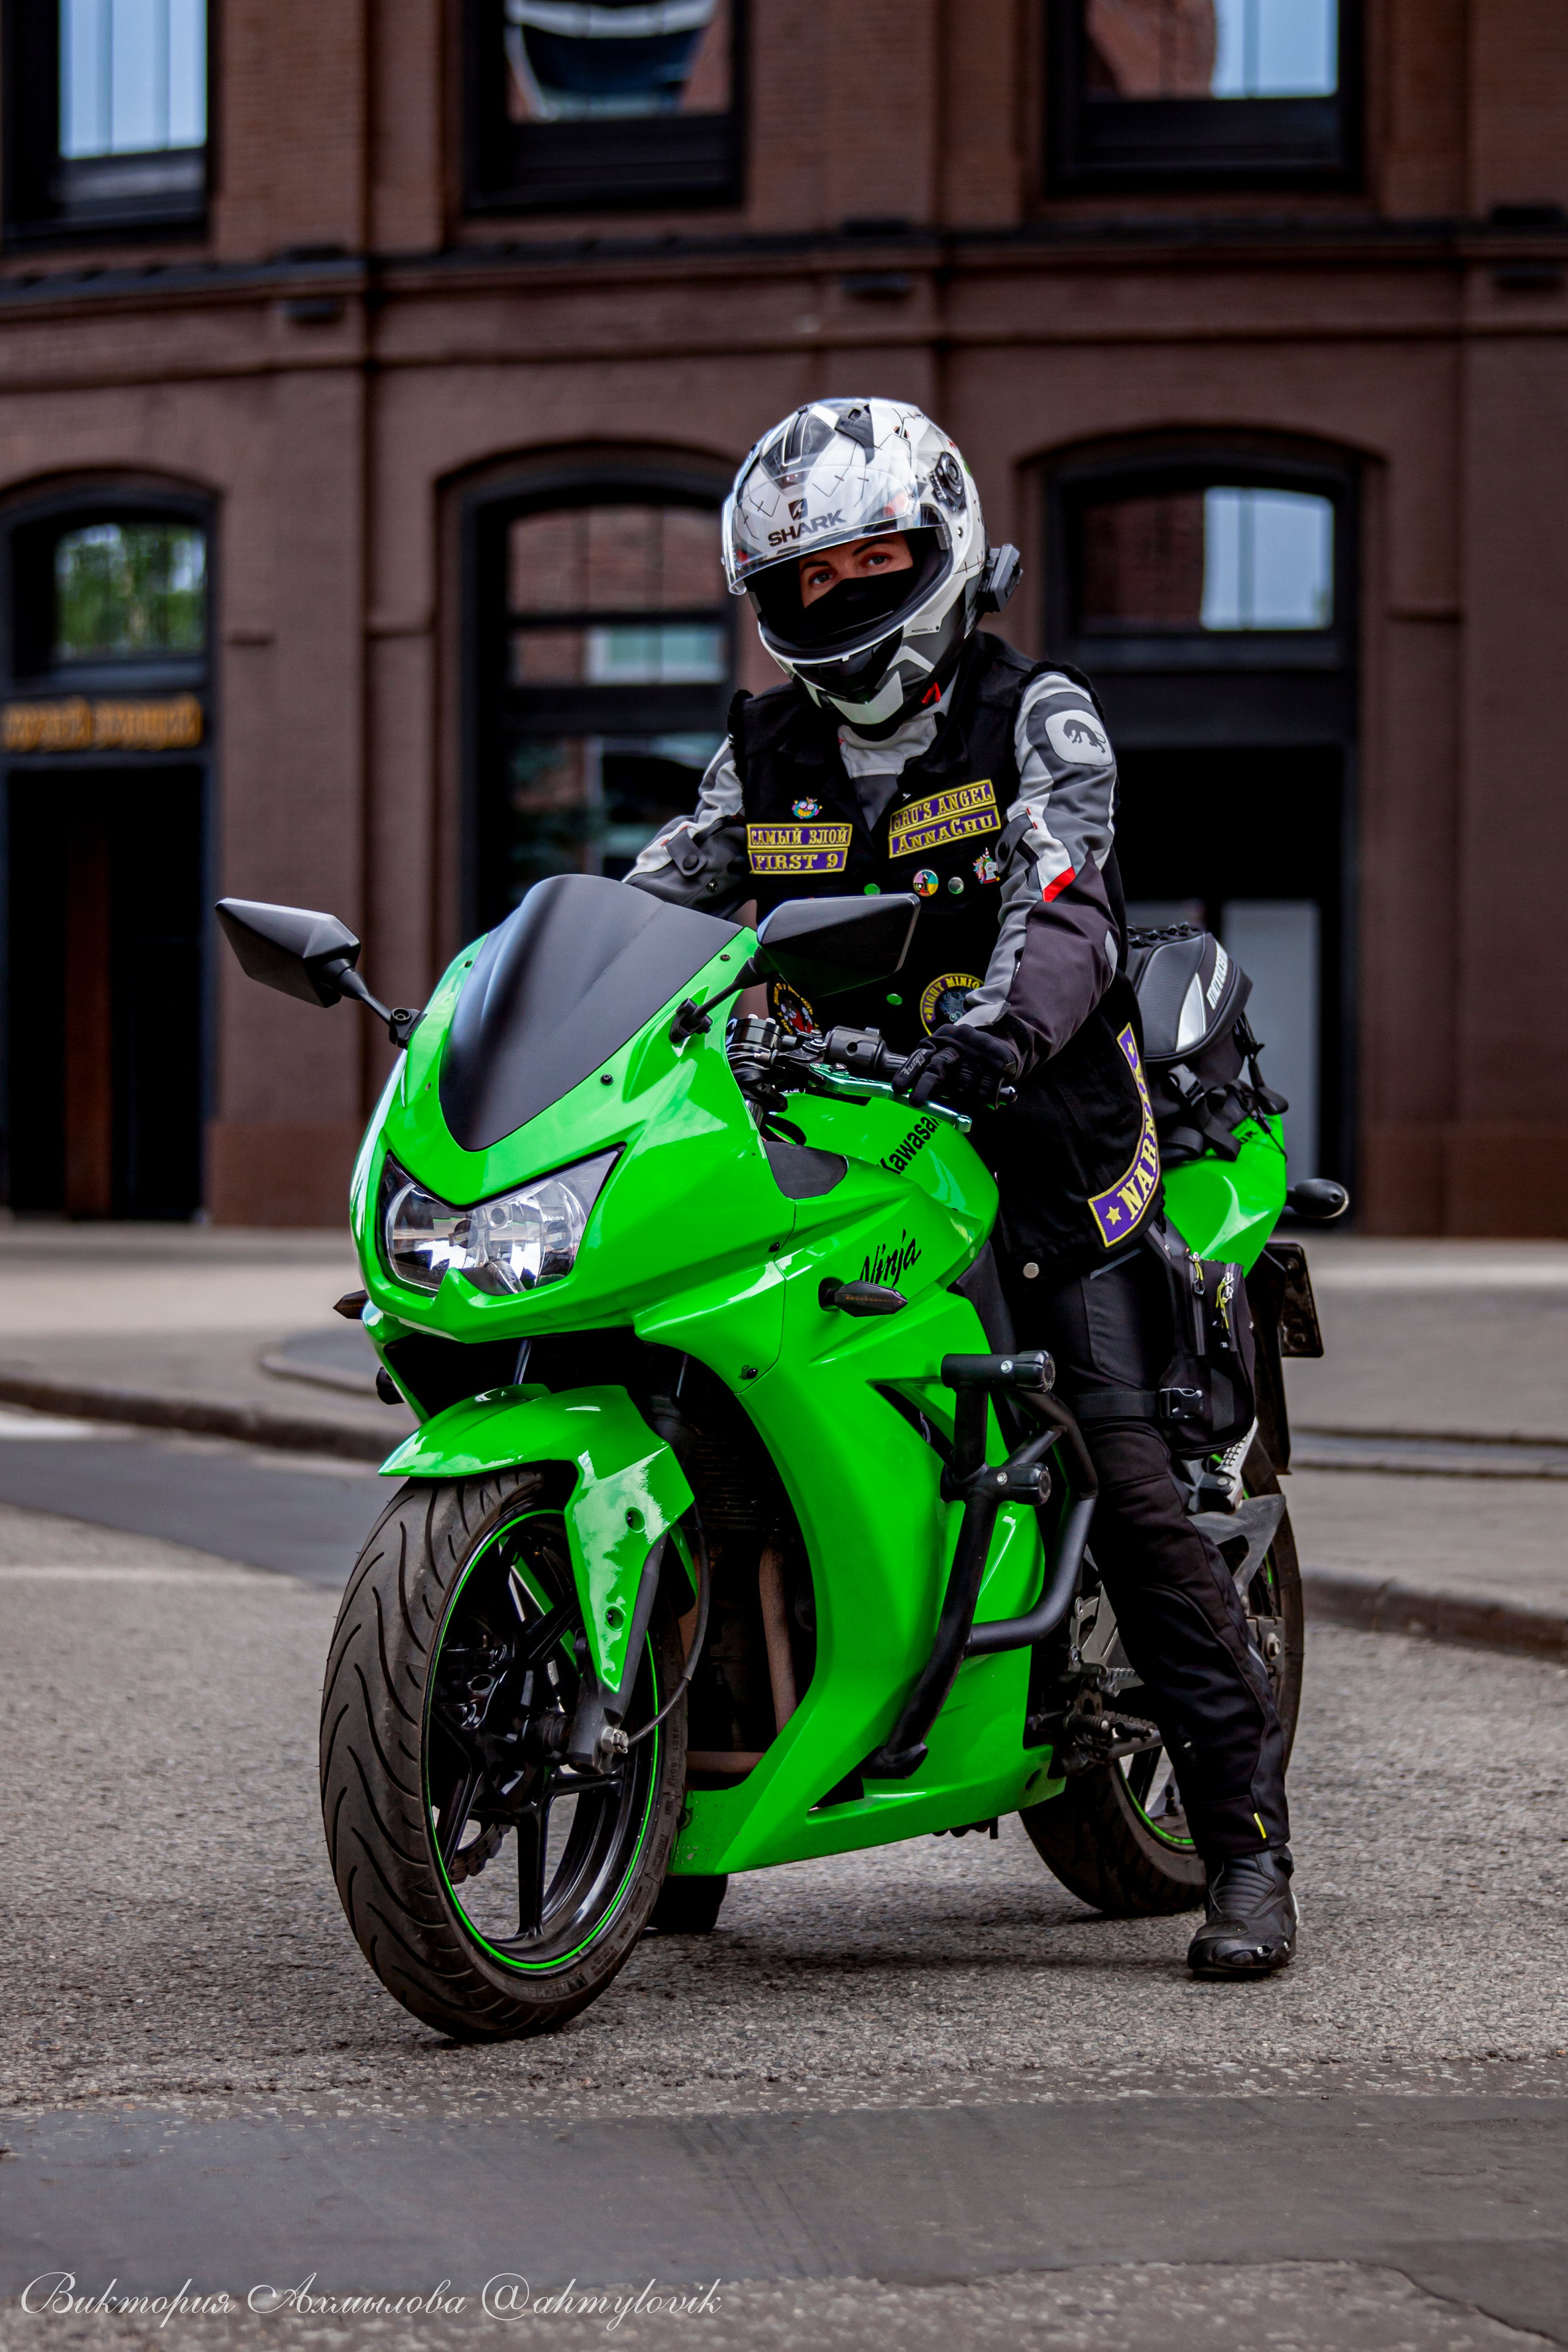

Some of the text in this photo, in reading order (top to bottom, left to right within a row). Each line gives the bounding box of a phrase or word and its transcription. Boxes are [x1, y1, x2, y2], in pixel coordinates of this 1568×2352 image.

[768, 509, 846, 547] SHARK
[894, 785, 992, 831] GRU'S ANGEL
[751, 827, 848, 845] САМЫЙ ЗЛОЙ
[755, 853, 839, 870] FIRST 9
[945, 976, 980, 989] MINIO
[877, 1116, 941, 1175] Kawasa
[859, 1229, 921, 1288] Ninja
